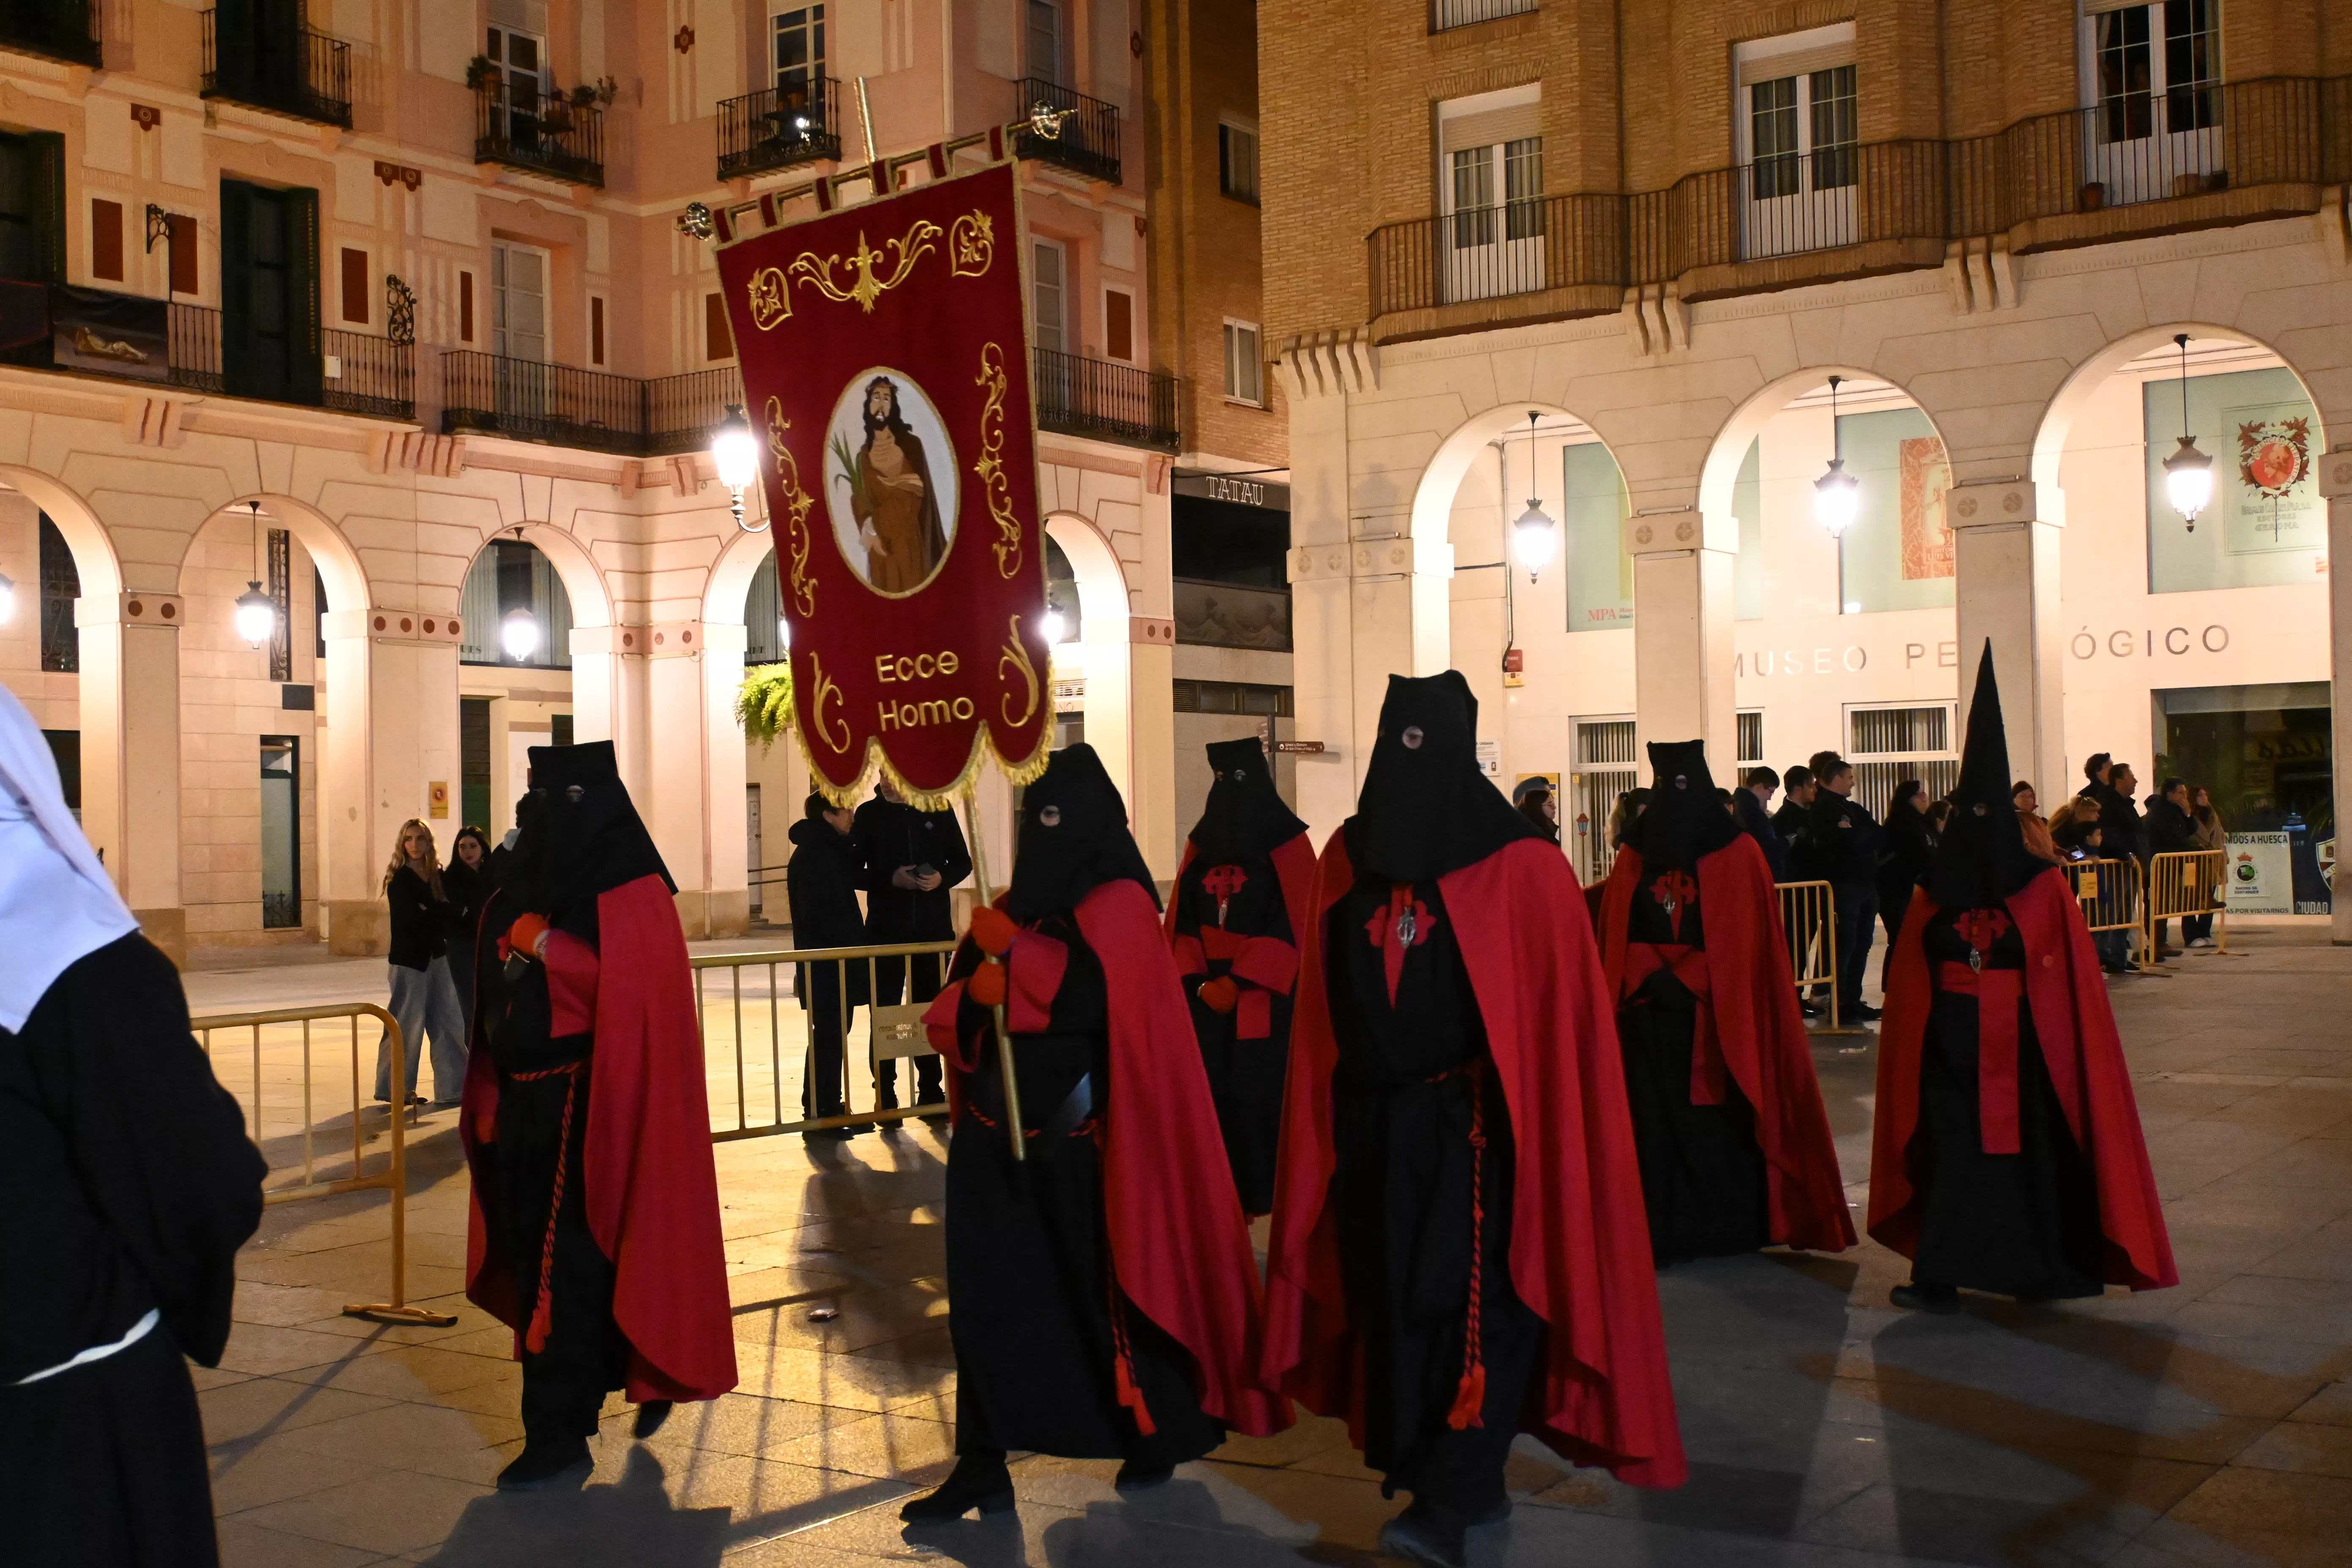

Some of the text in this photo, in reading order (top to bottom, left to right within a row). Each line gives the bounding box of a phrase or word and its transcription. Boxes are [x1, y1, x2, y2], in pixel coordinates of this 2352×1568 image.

[1206, 476, 1263, 505] TATAU
[1587, 608, 1617, 621] MPA
[876, 651, 958, 683] Ecce
[878, 697, 974, 732] Homo
[2251, 836, 2256, 844] A
[2257, 835, 2288, 844] HUESCA
[2296, 901, 2328, 915] CIUDAD
